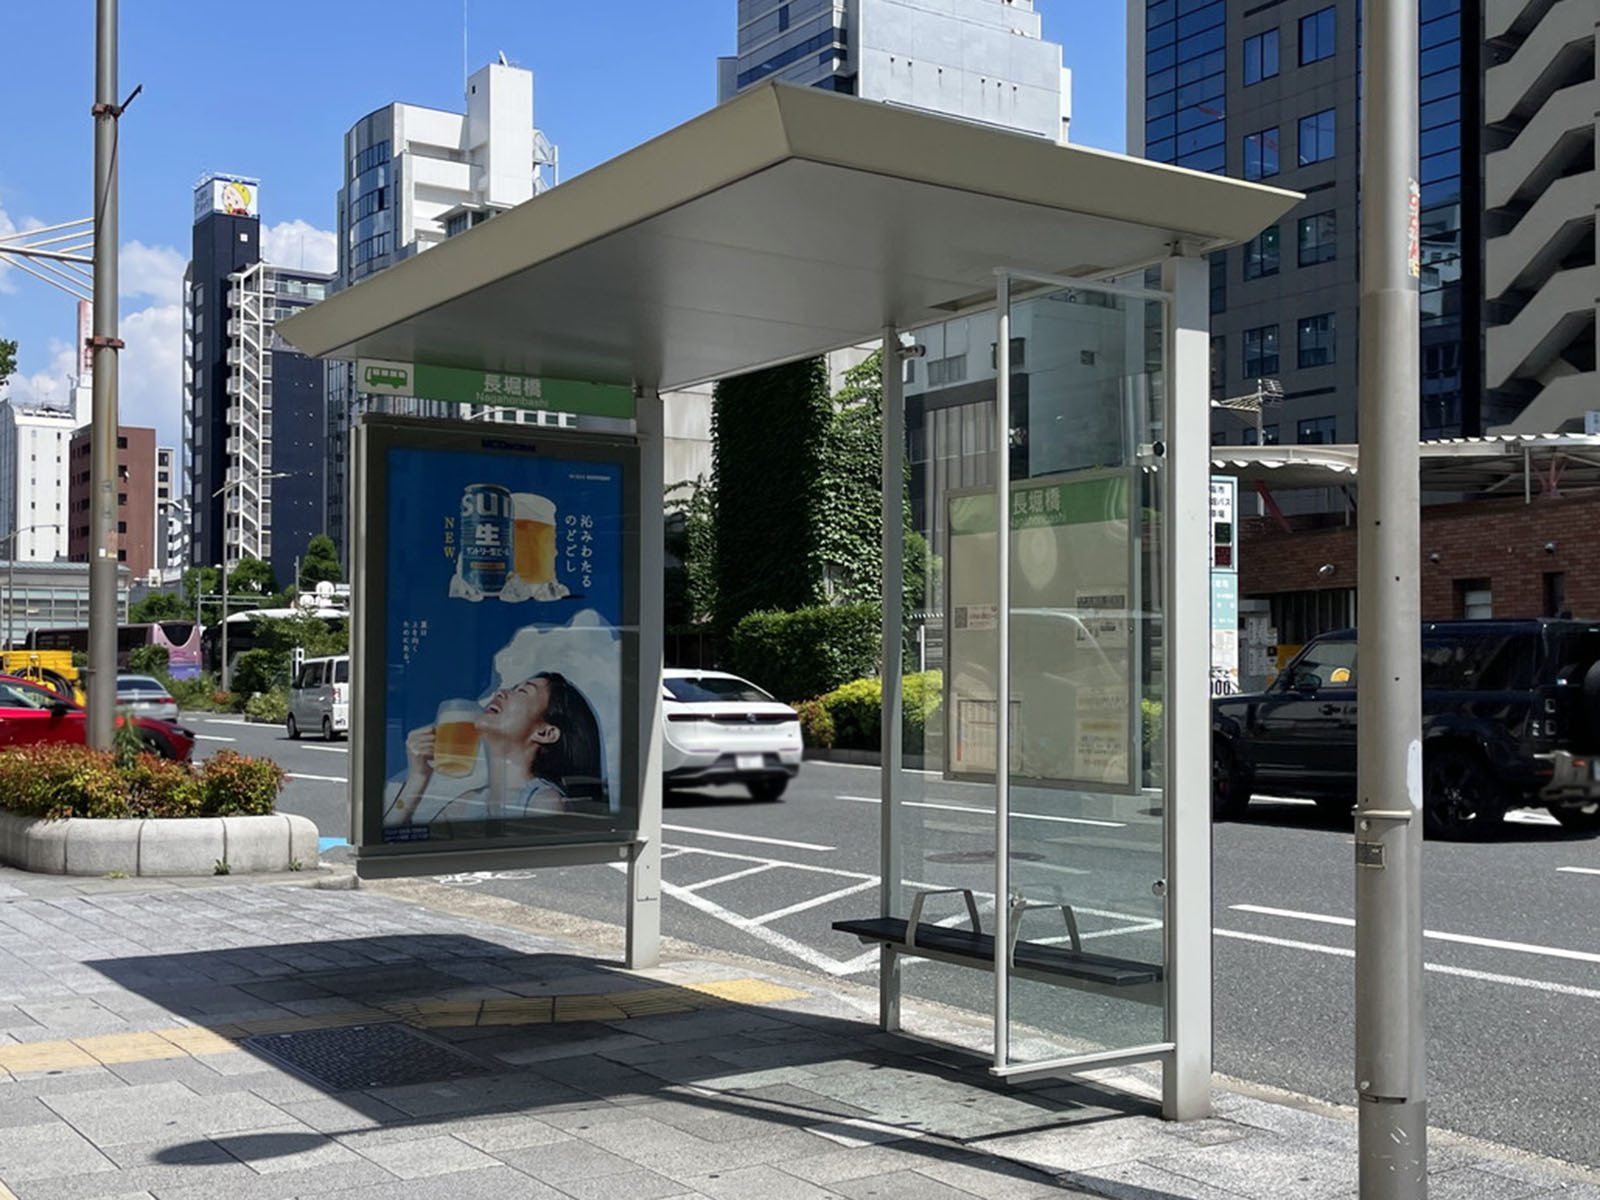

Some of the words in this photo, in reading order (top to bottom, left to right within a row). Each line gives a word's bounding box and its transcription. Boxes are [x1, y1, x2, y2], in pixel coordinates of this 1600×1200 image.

[483, 373, 542, 398] 長堀橋
[1012, 487, 1061, 515] 長堀橋
[475, 523, 501, 546] 生
[565, 514, 577, 573] のどごし
